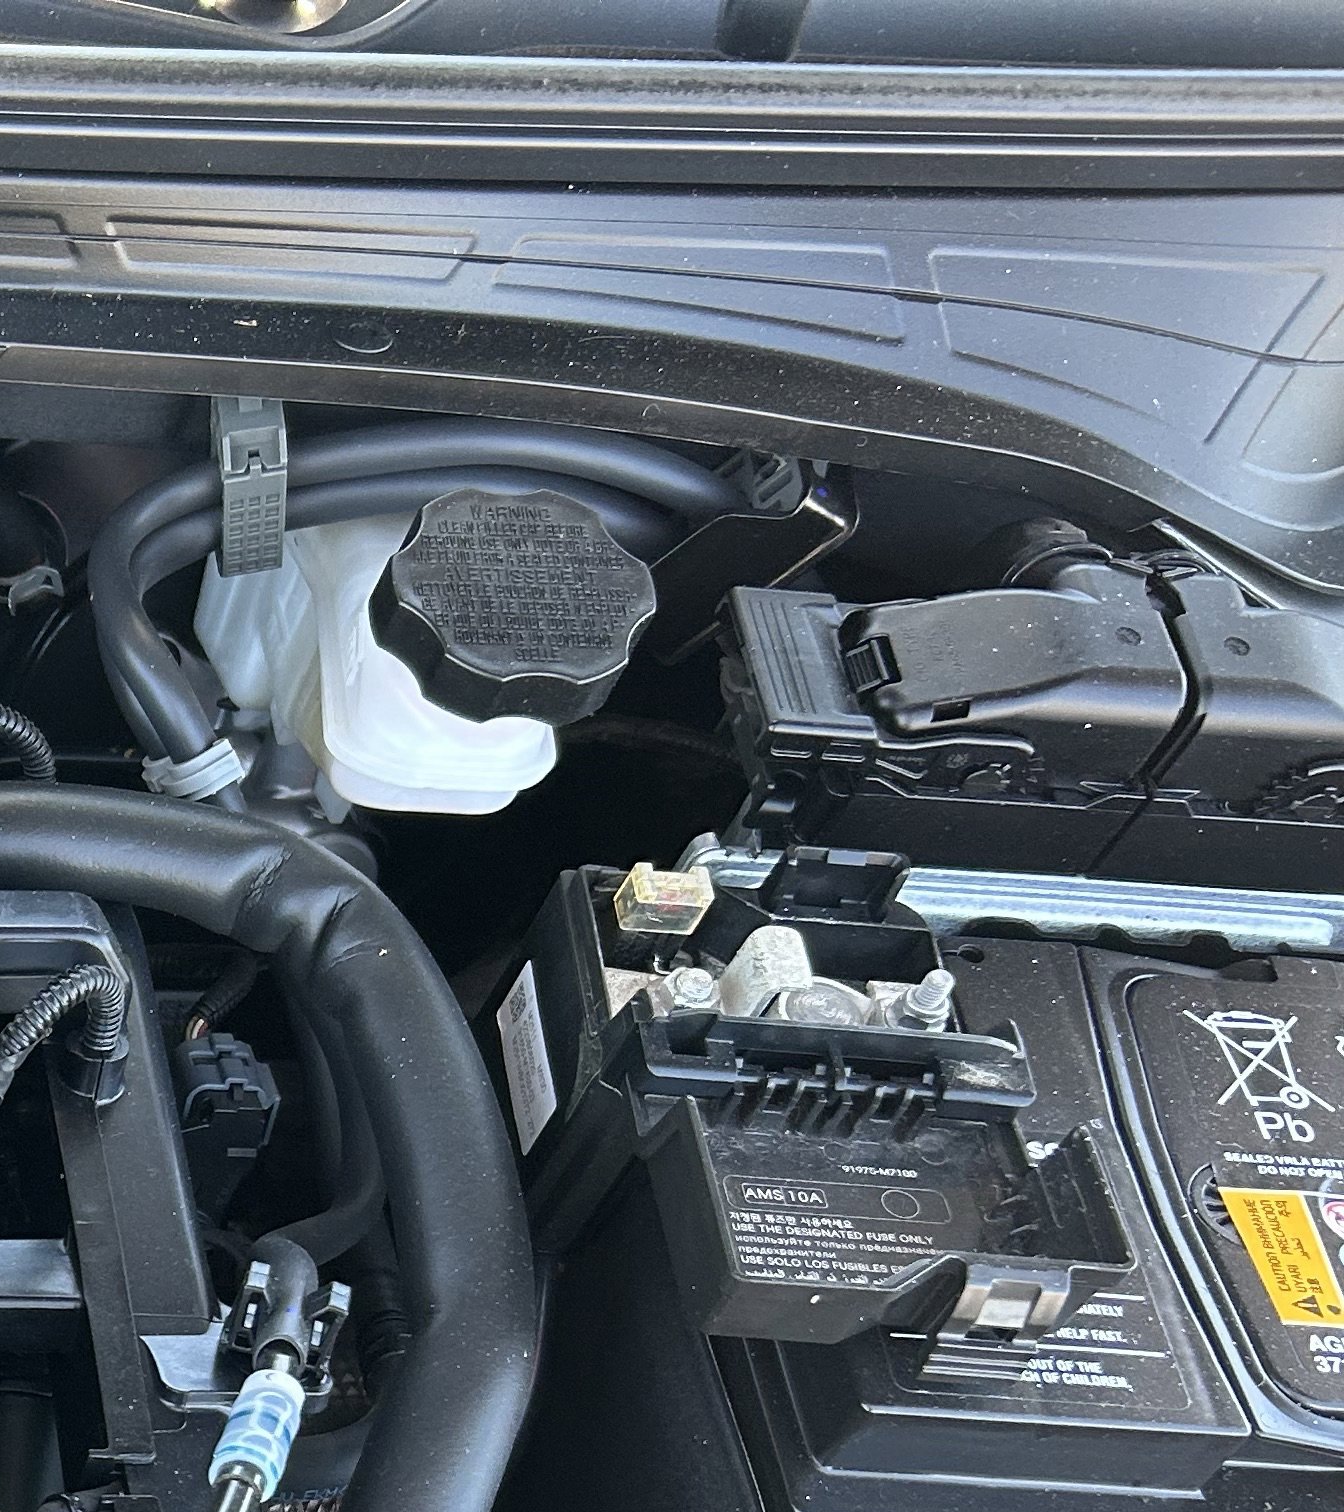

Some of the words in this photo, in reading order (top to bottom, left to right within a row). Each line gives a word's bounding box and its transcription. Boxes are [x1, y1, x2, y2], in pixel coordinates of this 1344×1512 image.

[469, 505, 552, 523] WARNING
[1254, 1110, 1315, 1143] Pb
[1223, 1152, 1274, 1164] SEALED
[1257, 1165, 1278, 1175] DO
[1279, 1166, 1305, 1177] NOT
[744, 1186, 784, 1201] AMS
[787, 1190, 824, 1204] 10A
[732, 1222, 756, 1233] USE
[757, 1224, 784, 1235] THE
[785, 1225, 864, 1240] DESIGNATED
[866, 1232, 897, 1242] FUSE
[898, 1234, 933, 1245] ONLY
[740, 1254, 765, 1265] USE
[766, 1256, 802, 1268] SOLO
[804, 1259, 830, 1270] LOS
[832, 1261, 889, 1273] FUSIBLES
[1267, 1250, 1291, 1292] CAUTION
[1056, 1359, 1075, 1371] OF
[1077, 1360, 1104, 1374] THE
